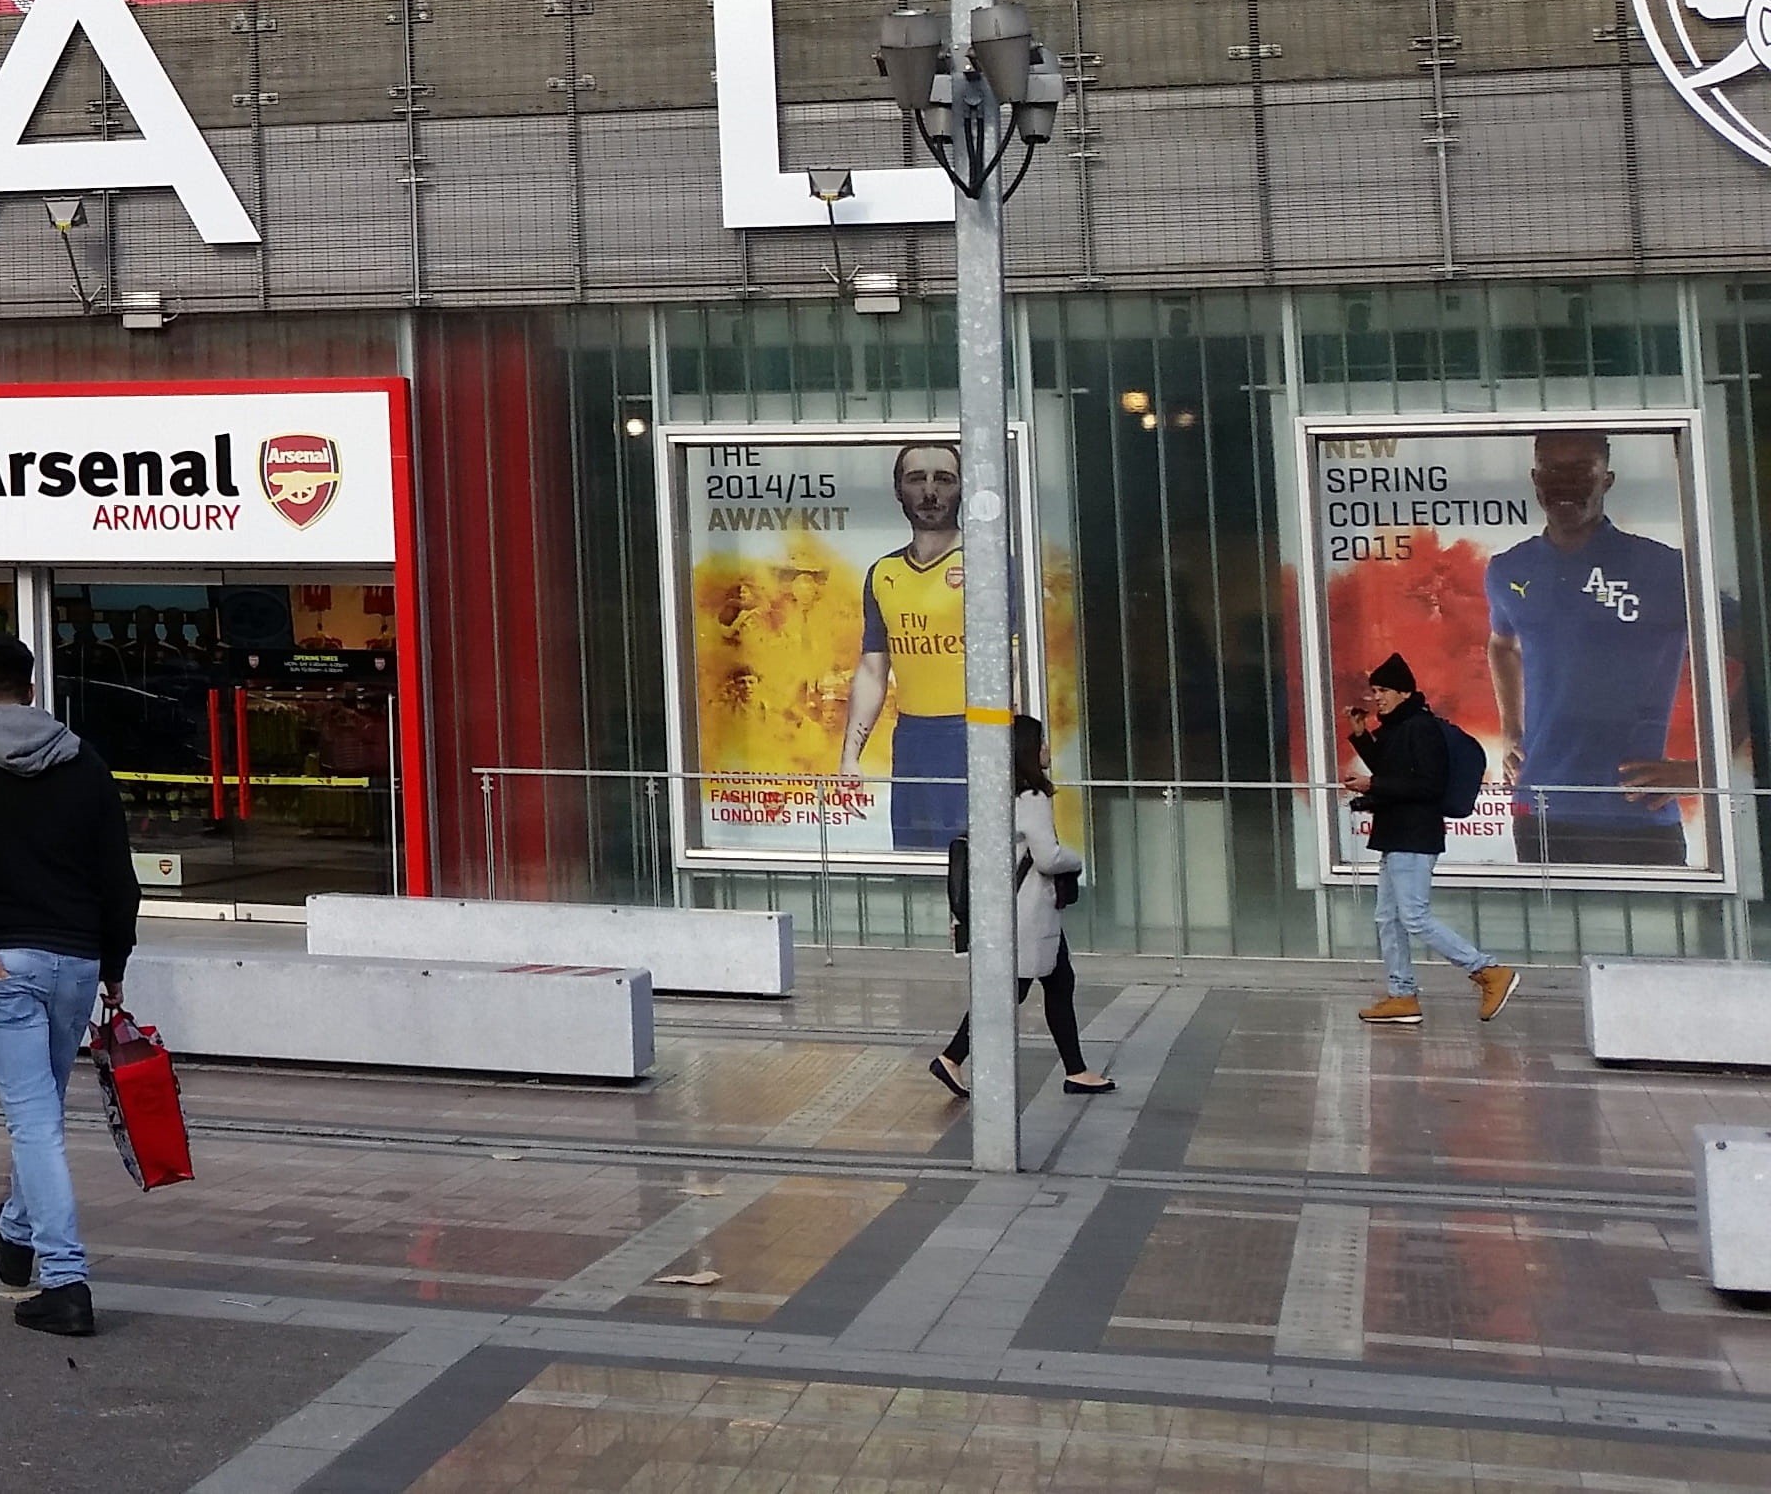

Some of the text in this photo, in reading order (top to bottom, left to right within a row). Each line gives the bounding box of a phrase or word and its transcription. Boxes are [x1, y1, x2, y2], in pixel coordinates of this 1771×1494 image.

[267, 447, 330, 464] Arsenal
[1325, 440, 1398, 459] NEW
[707, 473, 836, 504] 2014/15
[1327, 466, 1448, 494] SPRING
[92, 503, 241, 531] ARMOURY
[708, 506, 850, 531] AWAY KIT
[1329, 499, 1528, 527] COLLECTION
[1330, 534, 1412, 562] 2015
[1582, 567, 1640, 622] AFC
[900, 612, 928, 632] Fly
[889, 631, 966, 655] mirates
[711, 789, 876, 807] FASHION FOR NORTH
[797, 810, 852, 826] FINEST
[1443, 821, 1505, 837] FINEST
